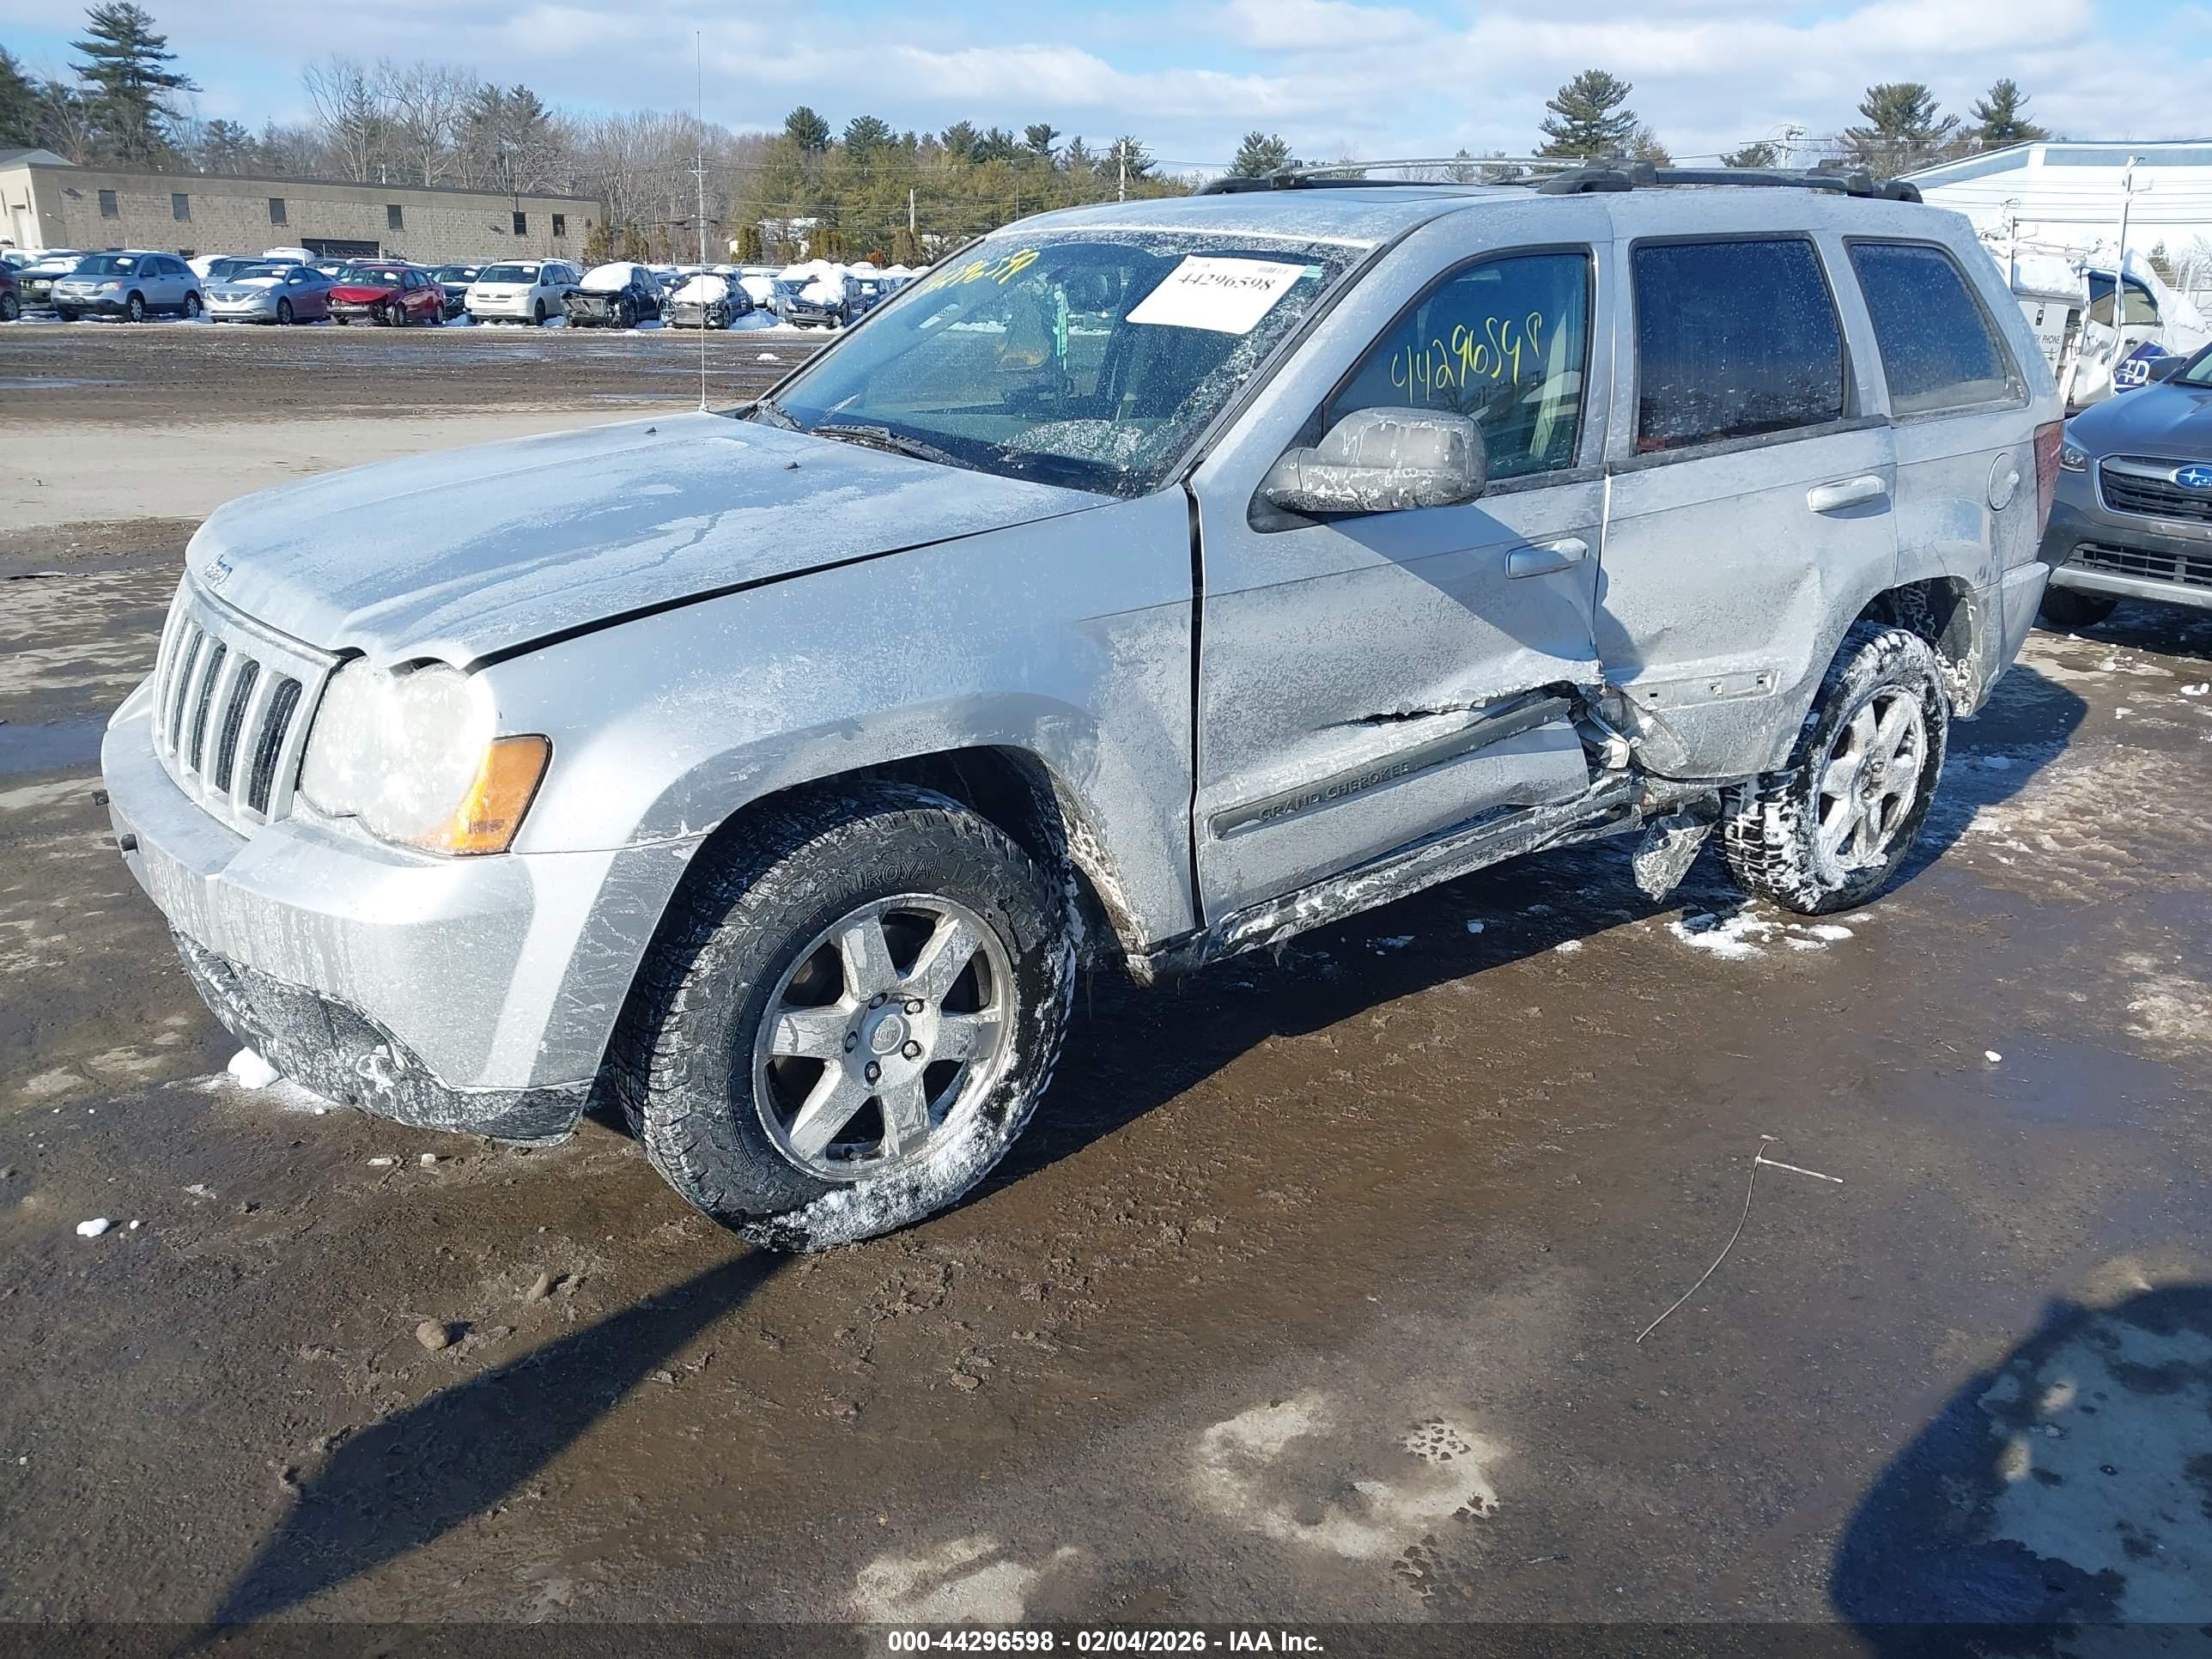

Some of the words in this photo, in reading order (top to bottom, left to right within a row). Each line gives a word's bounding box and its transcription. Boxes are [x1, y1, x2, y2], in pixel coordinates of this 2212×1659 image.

[1178, 272, 1276, 291] 44296598
[2042, 334, 2061, 344] PHONE
[1260, 792, 1322, 820] GRAND
[1325, 761, 1410, 801] CHEROKEE
[823, 859, 945, 905] UNIROYAL
